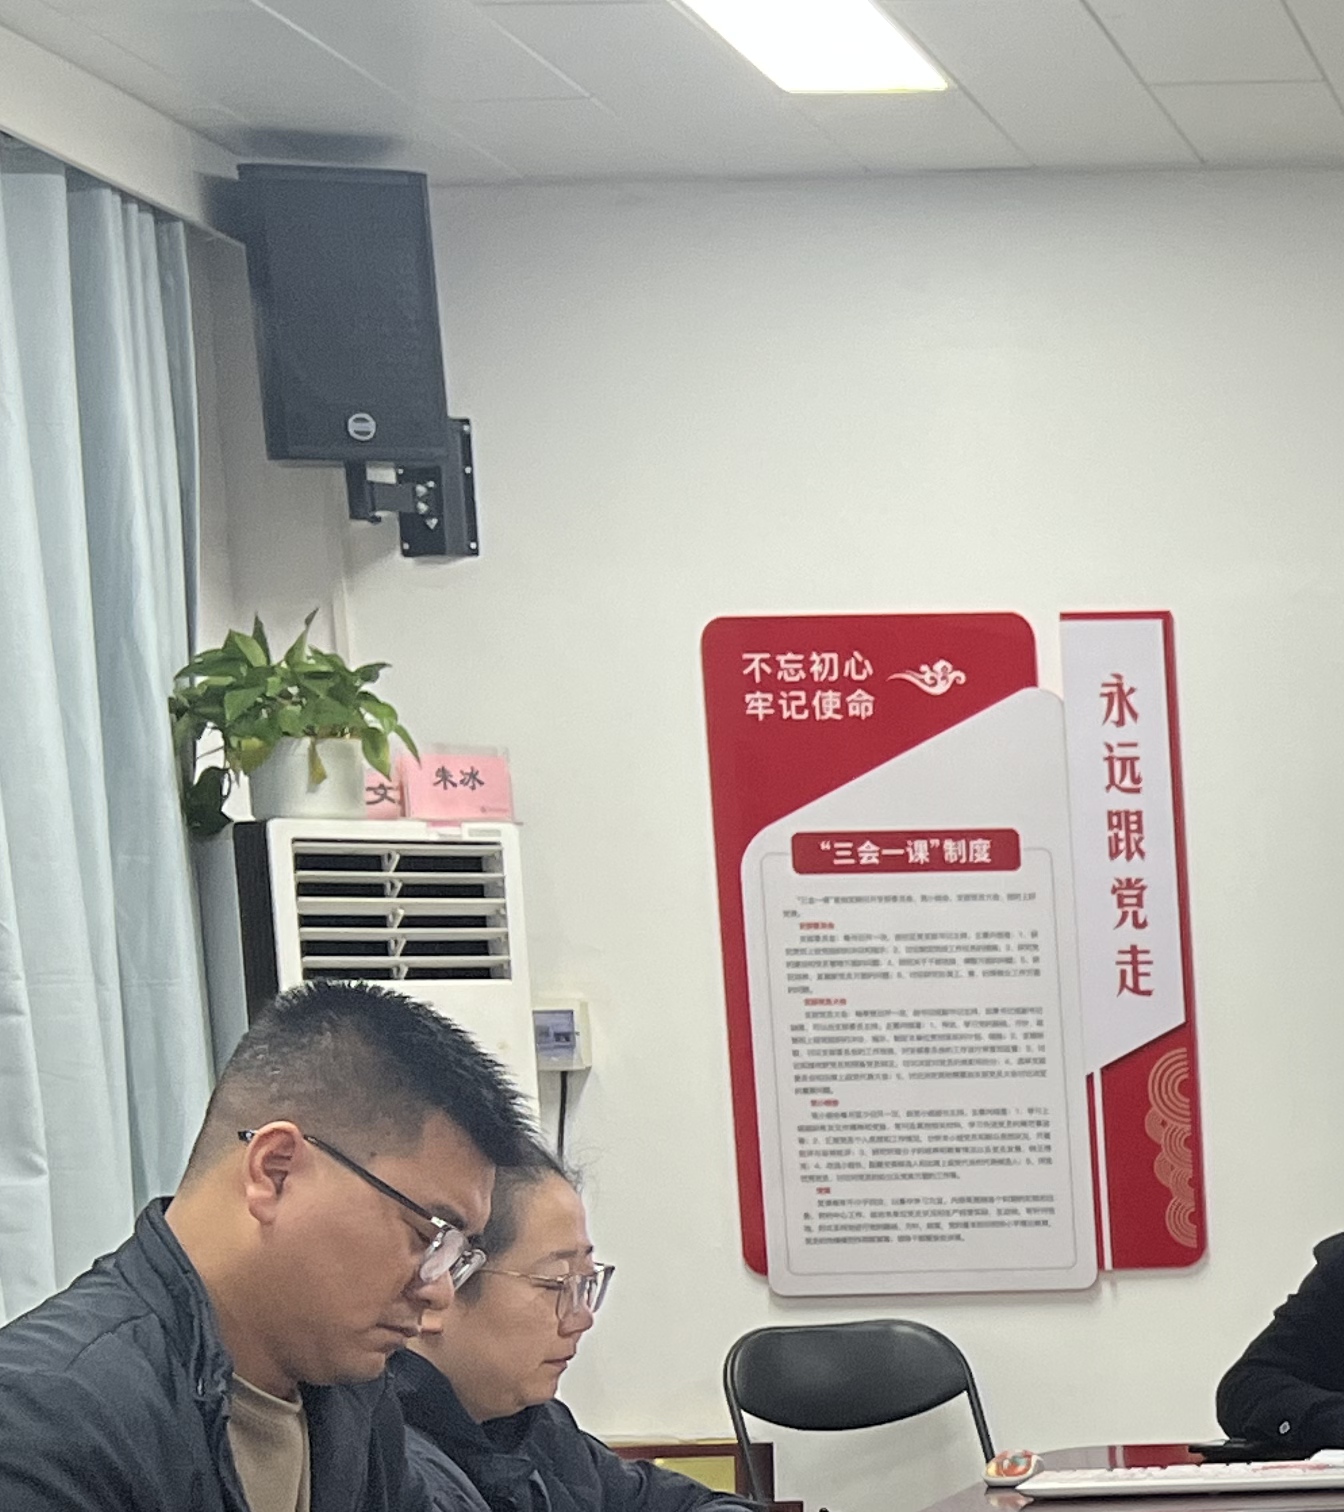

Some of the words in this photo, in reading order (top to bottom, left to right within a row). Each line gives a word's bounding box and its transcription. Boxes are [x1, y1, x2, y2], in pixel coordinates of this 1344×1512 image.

[742, 650, 874, 684] 不忘初心
[744, 688, 876, 721] 牢记使命
[432, 765, 486, 791] 朱冰
[1099, 672, 1156, 998] 永远跟党走
